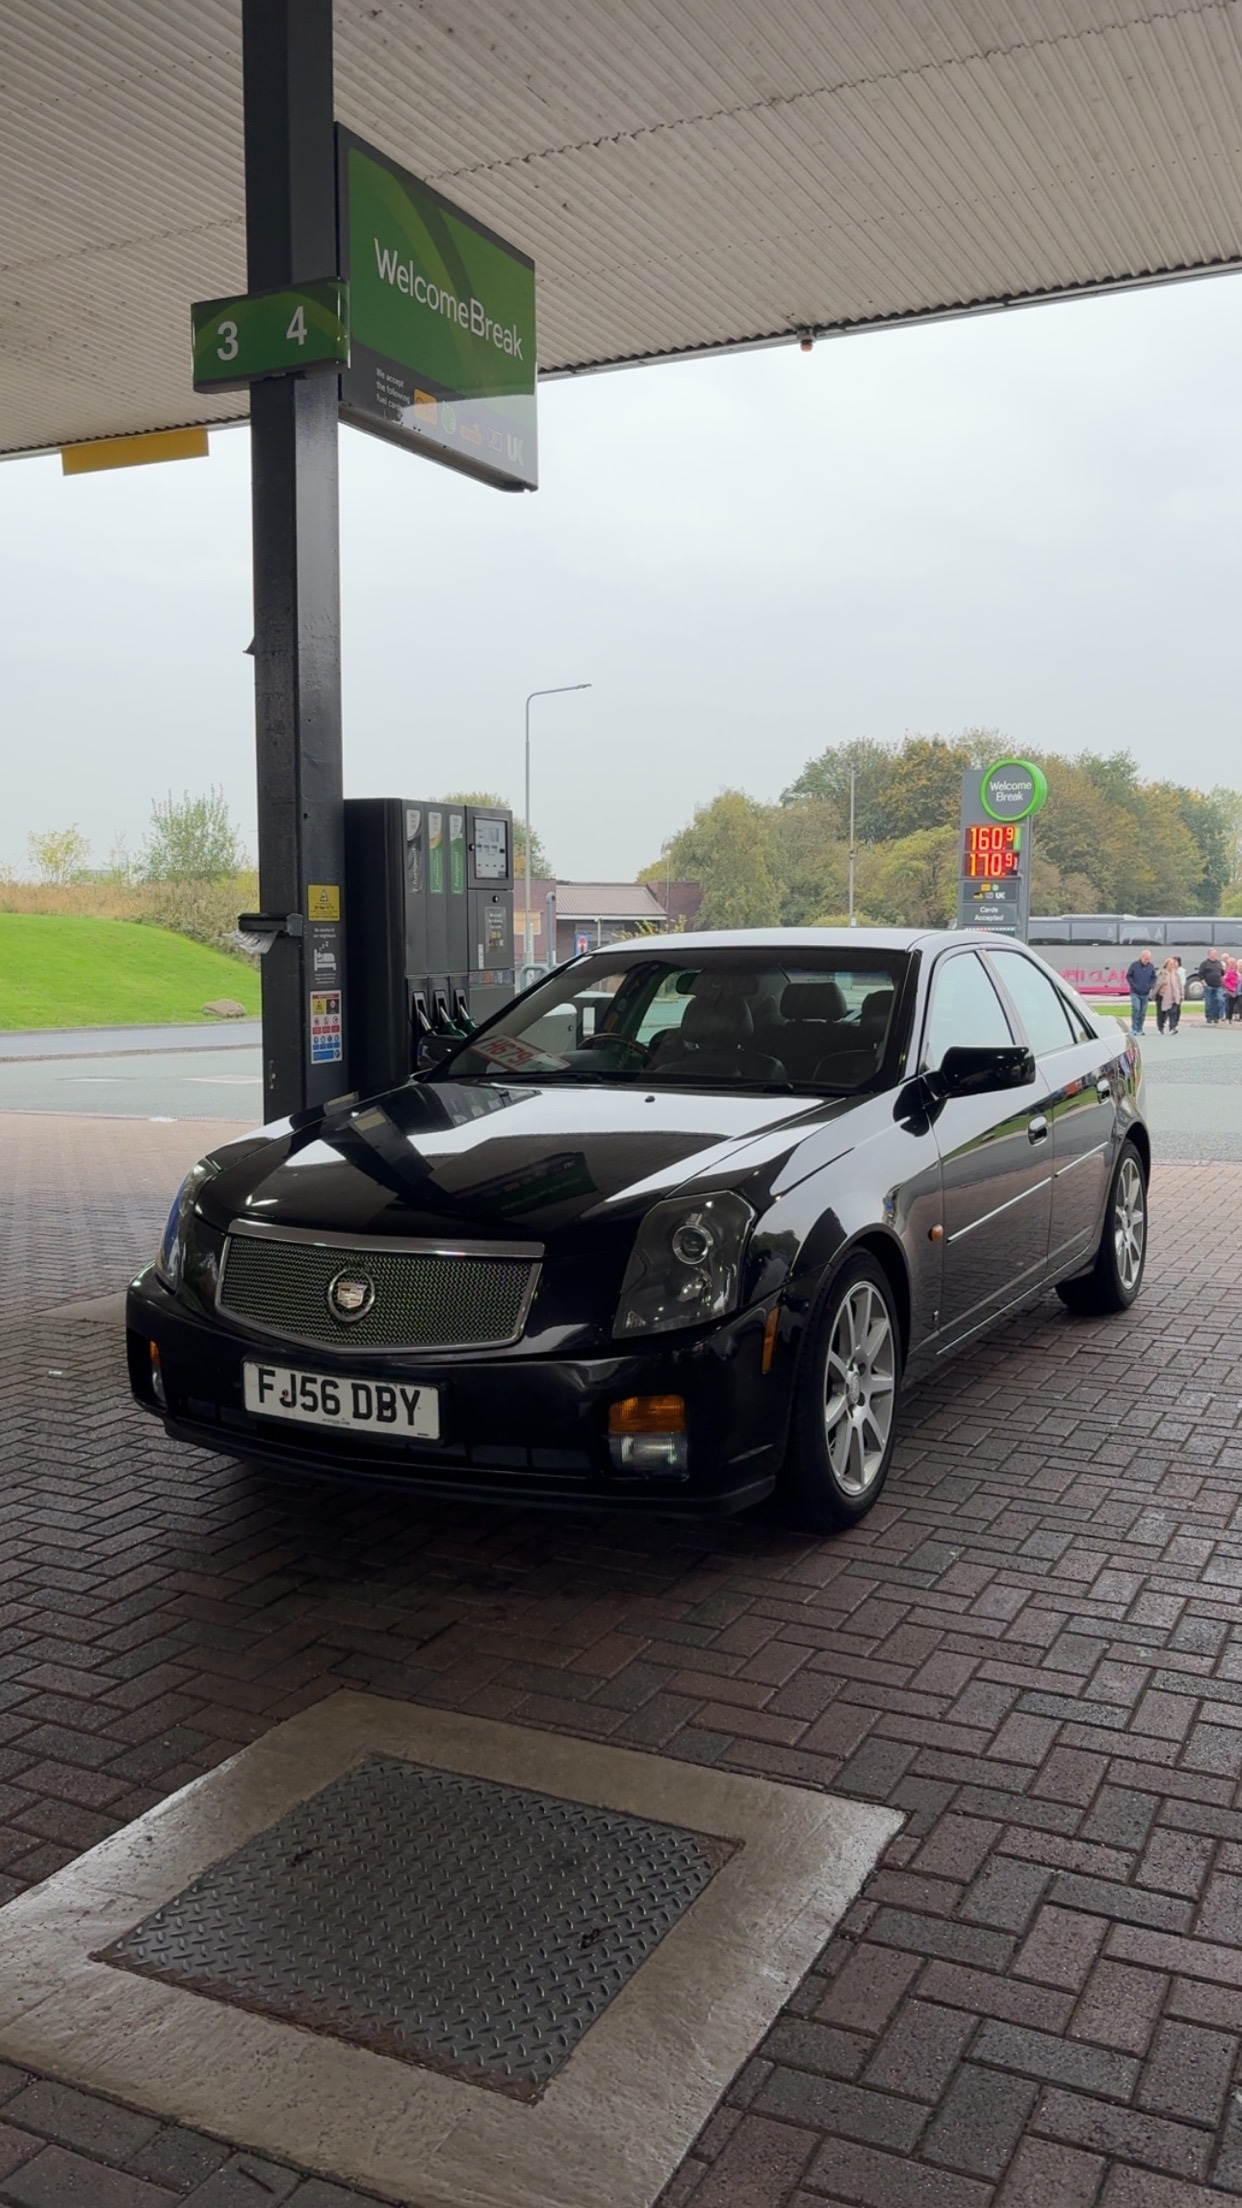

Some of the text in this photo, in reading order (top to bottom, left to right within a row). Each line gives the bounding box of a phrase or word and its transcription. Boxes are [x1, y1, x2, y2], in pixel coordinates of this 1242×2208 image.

[374, 237, 524, 361] WelcomeBreak
[216, 305, 308, 361] 3 4
[990, 780, 1032, 792] Welcome
[996, 791, 1024, 802] Break
[970, 827, 1014, 851] 160.9
[969, 853, 1013, 877] 170.9
[974, 914, 1004, 922] Accepted
[980, 906, 999, 914] Cards
[258, 1368, 421, 1427] FJ56 DBY
